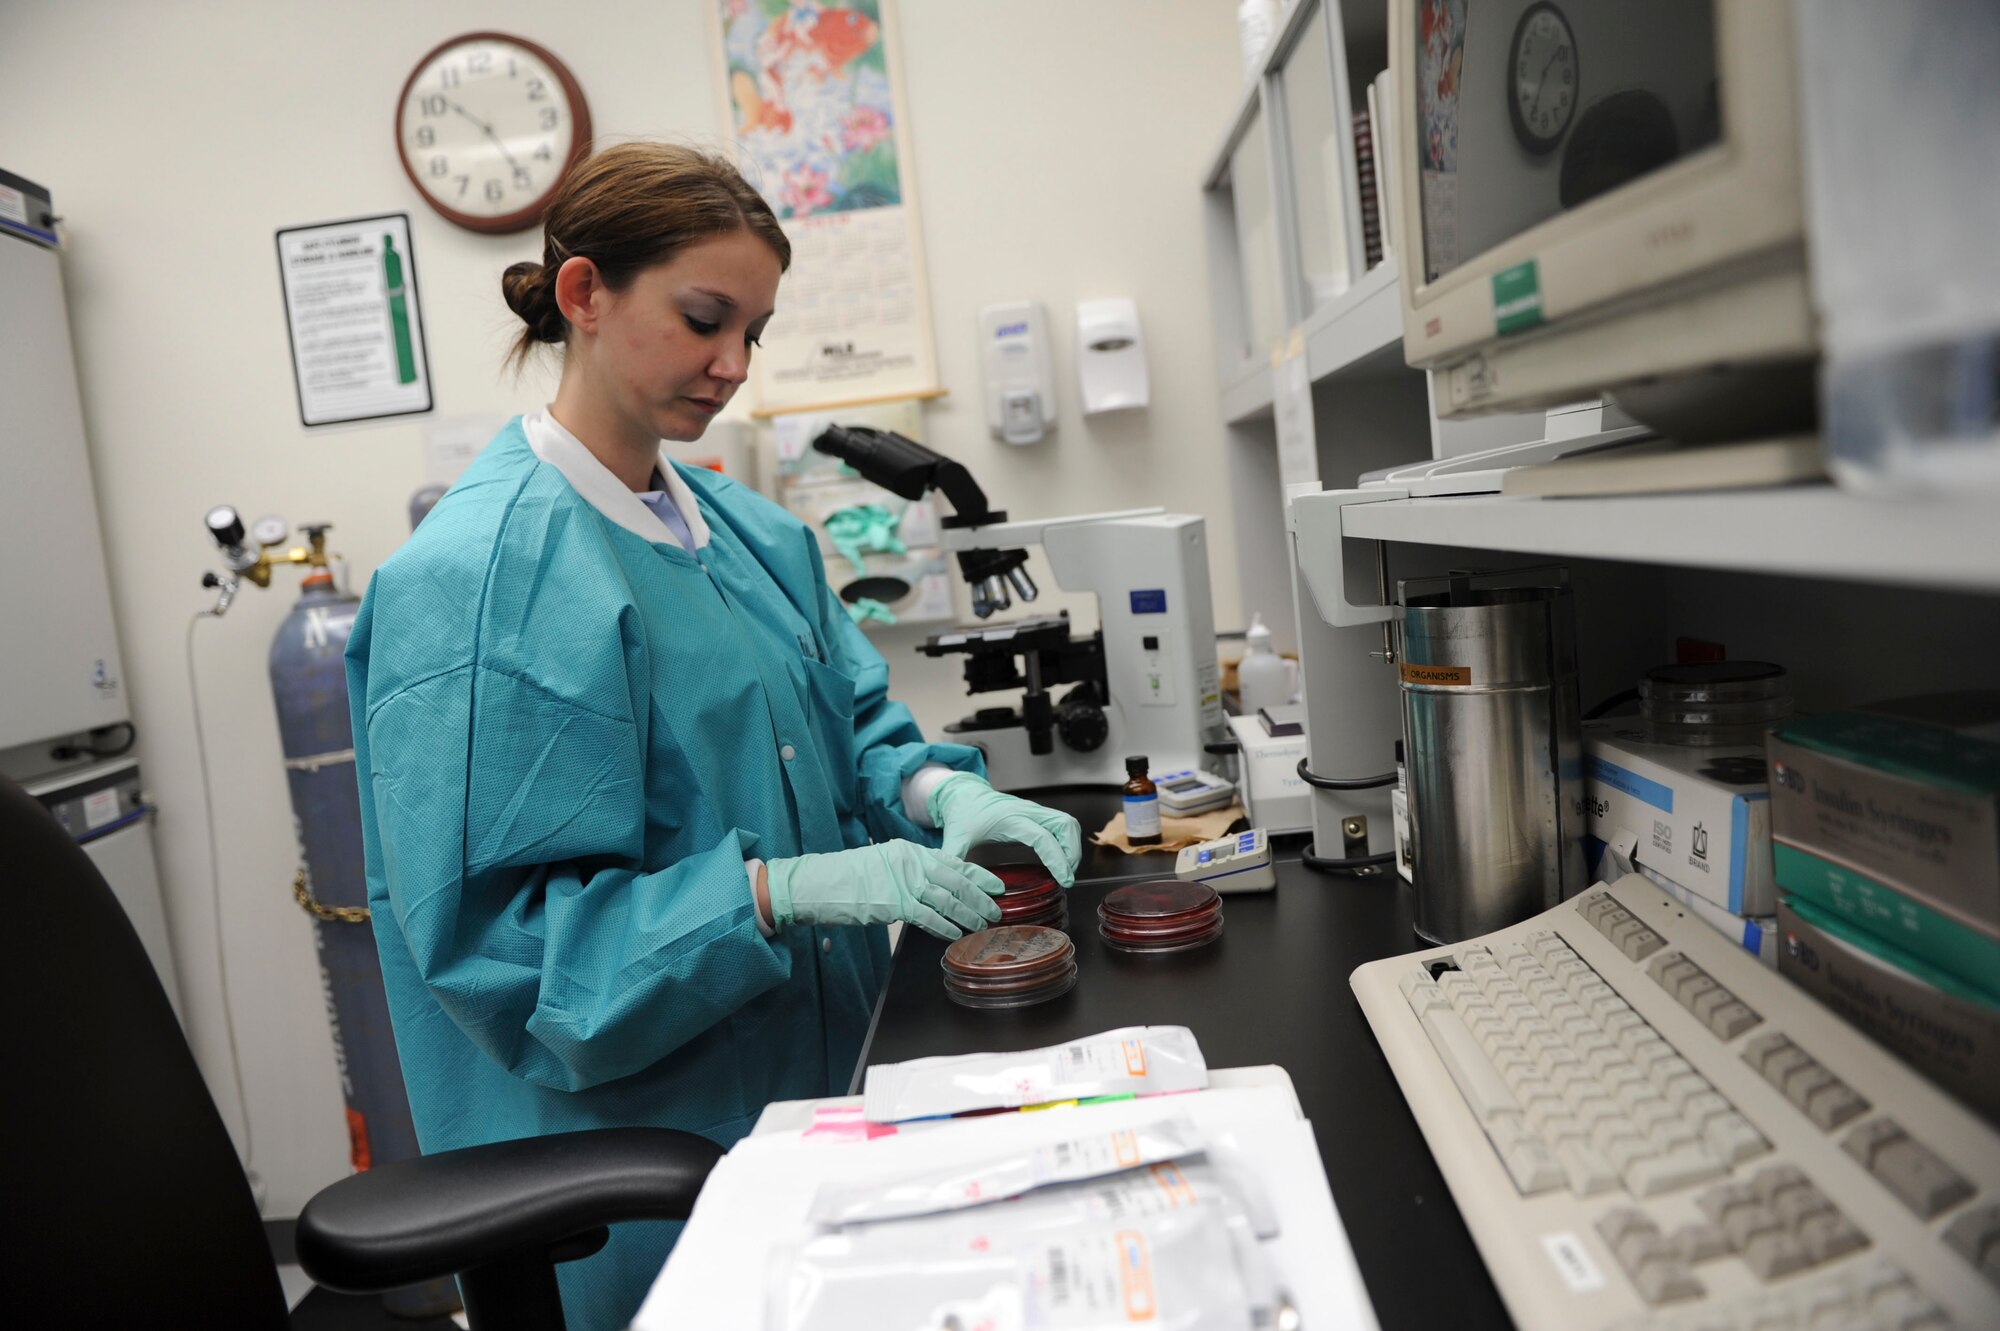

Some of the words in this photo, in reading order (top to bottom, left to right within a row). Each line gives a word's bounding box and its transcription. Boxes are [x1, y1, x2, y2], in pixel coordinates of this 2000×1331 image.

[468, 52, 491, 74] 12
[508, 58, 517, 79] 1
[441, 65, 459, 89] 11
[526, 78, 545, 101] 2
[421, 94, 447, 117] 10
[541, 107, 557, 131] 3
[417, 126, 434, 147] 9
[532, 143, 551, 162] 4
[430, 155, 448, 177] 8
[454, 174, 469, 195] 7
[513, 167, 531, 191] 5
[485, 178, 503, 203] 6
[305, 606, 329, 648] N
[1410, 670, 1460, 681] ORGANISMS
[1786, 766, 1806, 793] BD
[1813, 780, 1864, 817] Insulin
[1866, 797, 1952, 845] Syringes
[1653, 819, 1672, 841] ISO
[1688, 855, 1710, 874] BRAND
